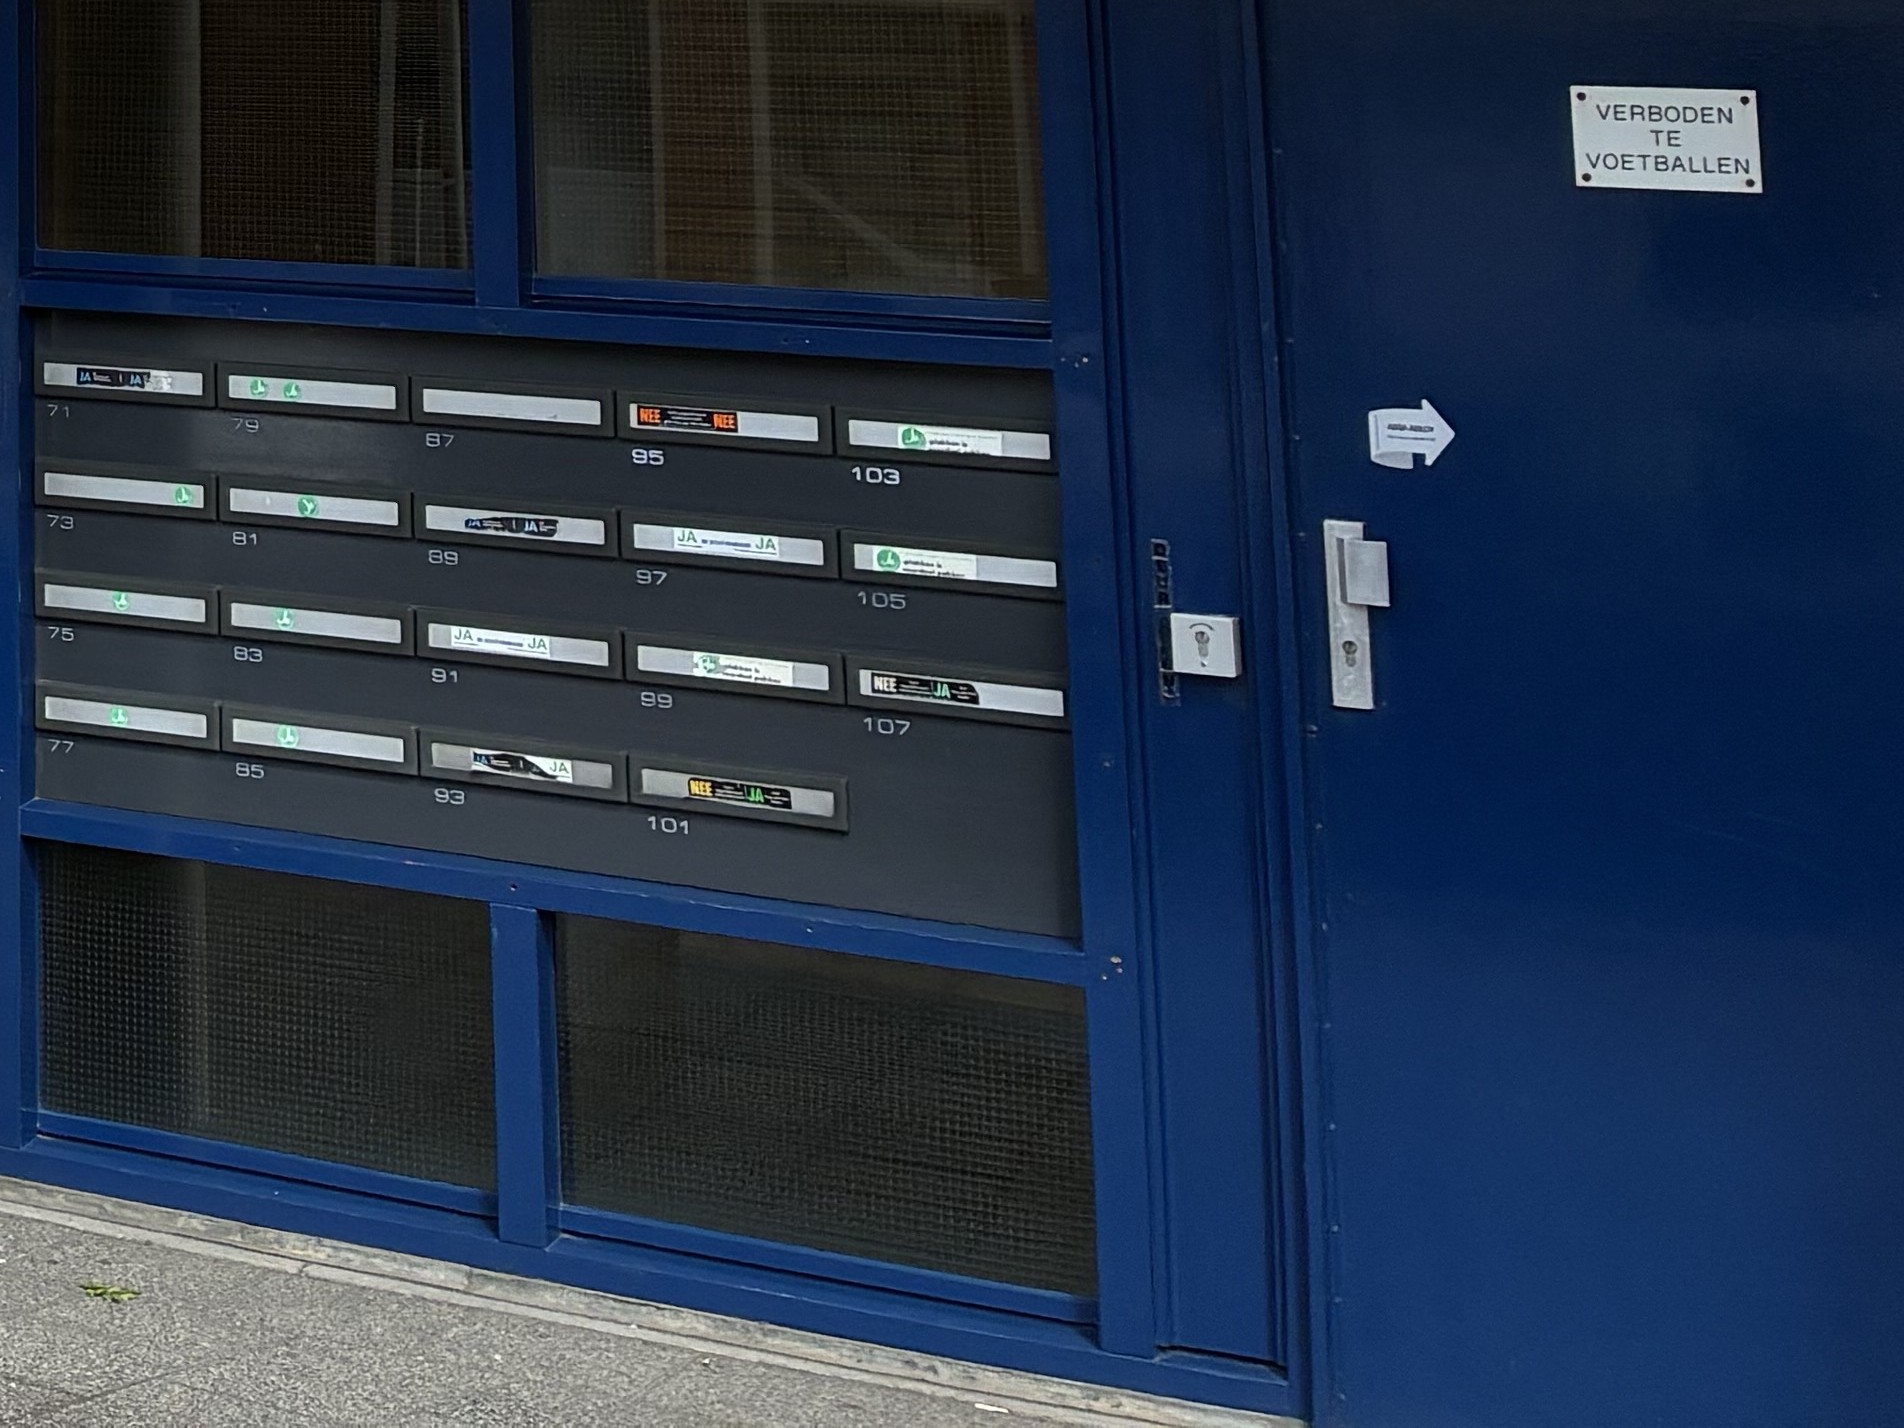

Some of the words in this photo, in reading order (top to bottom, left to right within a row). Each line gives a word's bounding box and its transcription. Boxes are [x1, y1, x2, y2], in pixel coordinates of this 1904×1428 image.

[1596, 103, 1733, 124] VERBODEN
[1649, 129, 1682, 147] TE
[1585, 152, 1751, 175] VOETBALLEN
[47, 403, 71, 419] 71
[639, 407, 662, 424] NEE
[713, 413, 737, 430] NEE
[231, 416, 260, 433] 79
[425, 432, 455, 448] 87
[631, 448, 665, 466] 95
[850, 466, 901, 486] 103
[46, 513, 75, 530] 73
[231, 531, 258, 547] 81
[676, 529, 698, 544] JA
[754, 536, 777, 551] JA
[427, 548, 459, 566] 89
[635, 568, 668, 586] 97
[857, 590, 907, 610] 105
[47, 625, 75, 643] 75
[453, 628, 474, 642] JA
[527, 636, 548, 651] JA
[233, 646, 264, 663] 83
[430, 667, 459, 684] 91
[873, 675, 898, 693] NEE
[933, 681, 952, 699] JA
[640, 691, 673, 709] 99
[863, 716, 911, 736] 107
[47, 738, 75, 754] 77
[234, 761, 265, 780] 85
[548, 760, 571, 775] JA
[433, 787, 466, 806] 93
[689, 779, 714, 797] NEE
[746, 787, 765, 804] JA
[647, 815, 689, 835] 101
